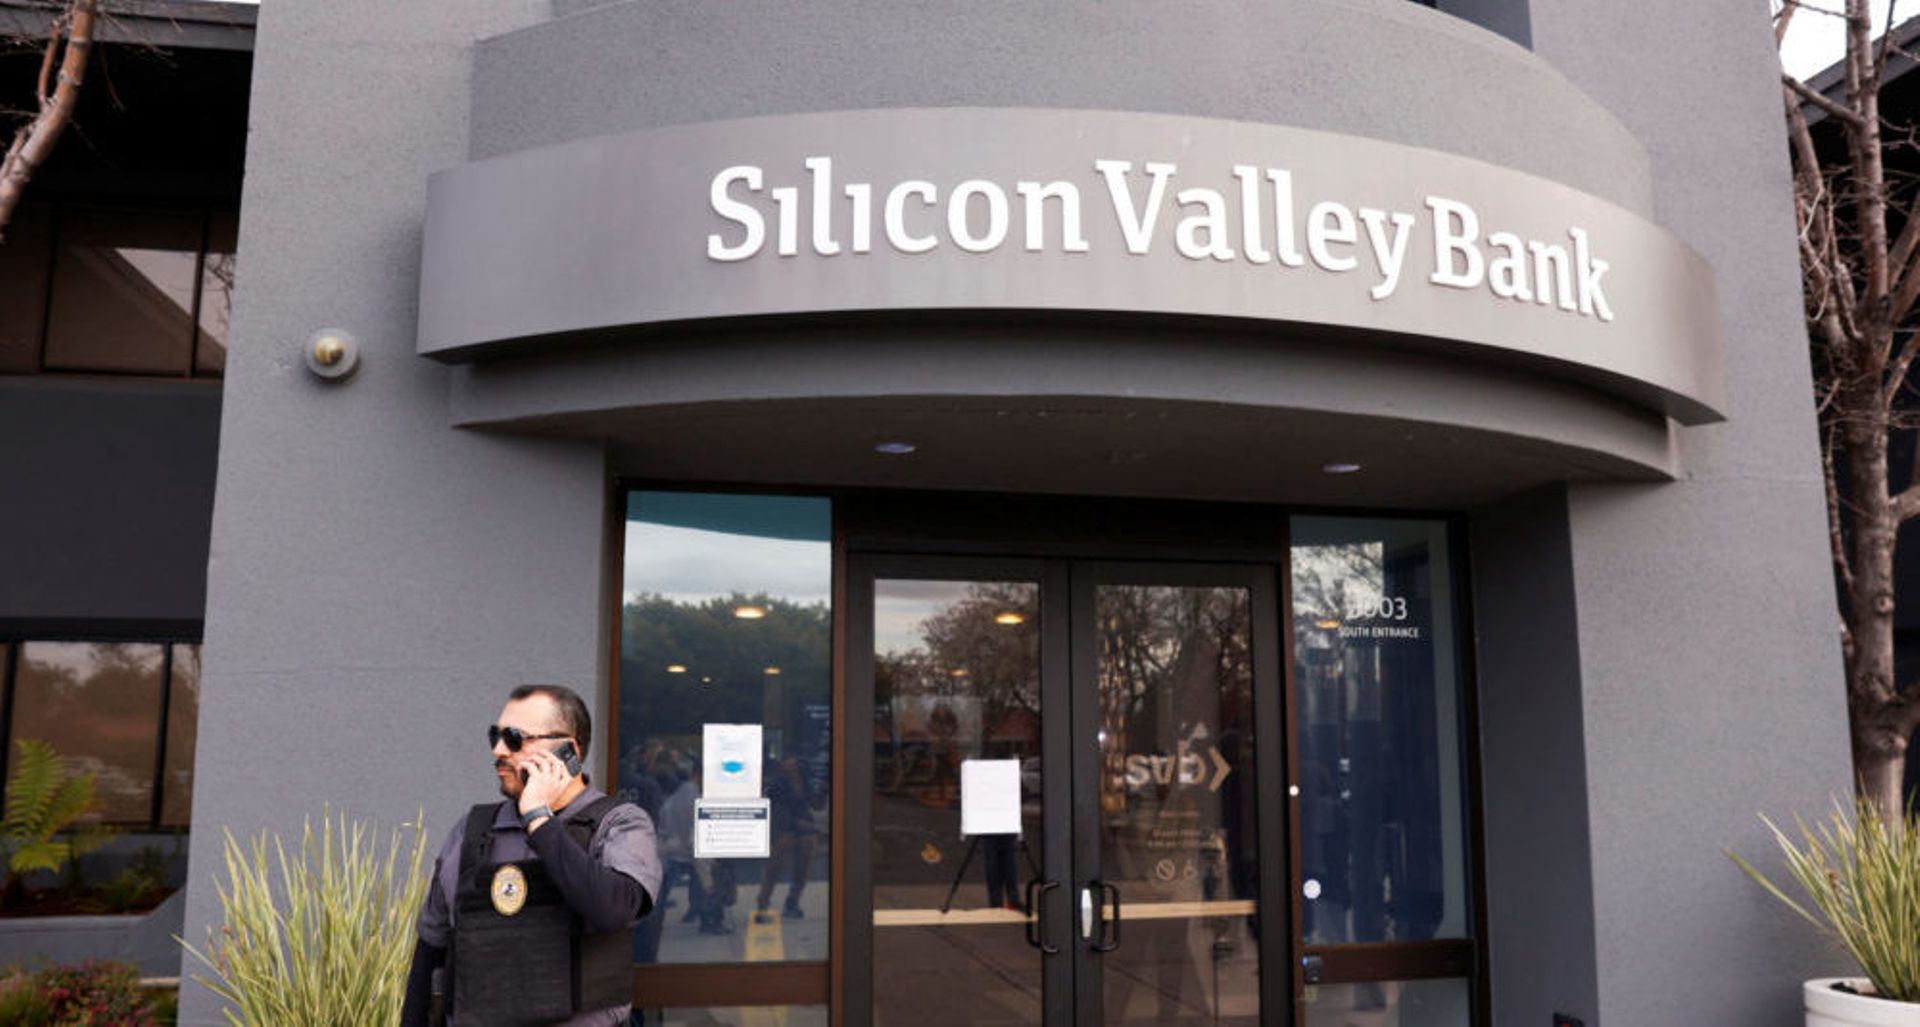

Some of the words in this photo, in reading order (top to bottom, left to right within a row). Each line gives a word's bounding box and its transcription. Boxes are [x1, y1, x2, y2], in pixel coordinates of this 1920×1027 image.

[707, 156, 1090, 261] Silicon
[1094, 159, 1415, 300] Valley
[1425, 195, 1615, 321] Bank
[1338, 627, 1369, 638] SOUTH
[1372, 627, 1419, 638] ENTRANCE
